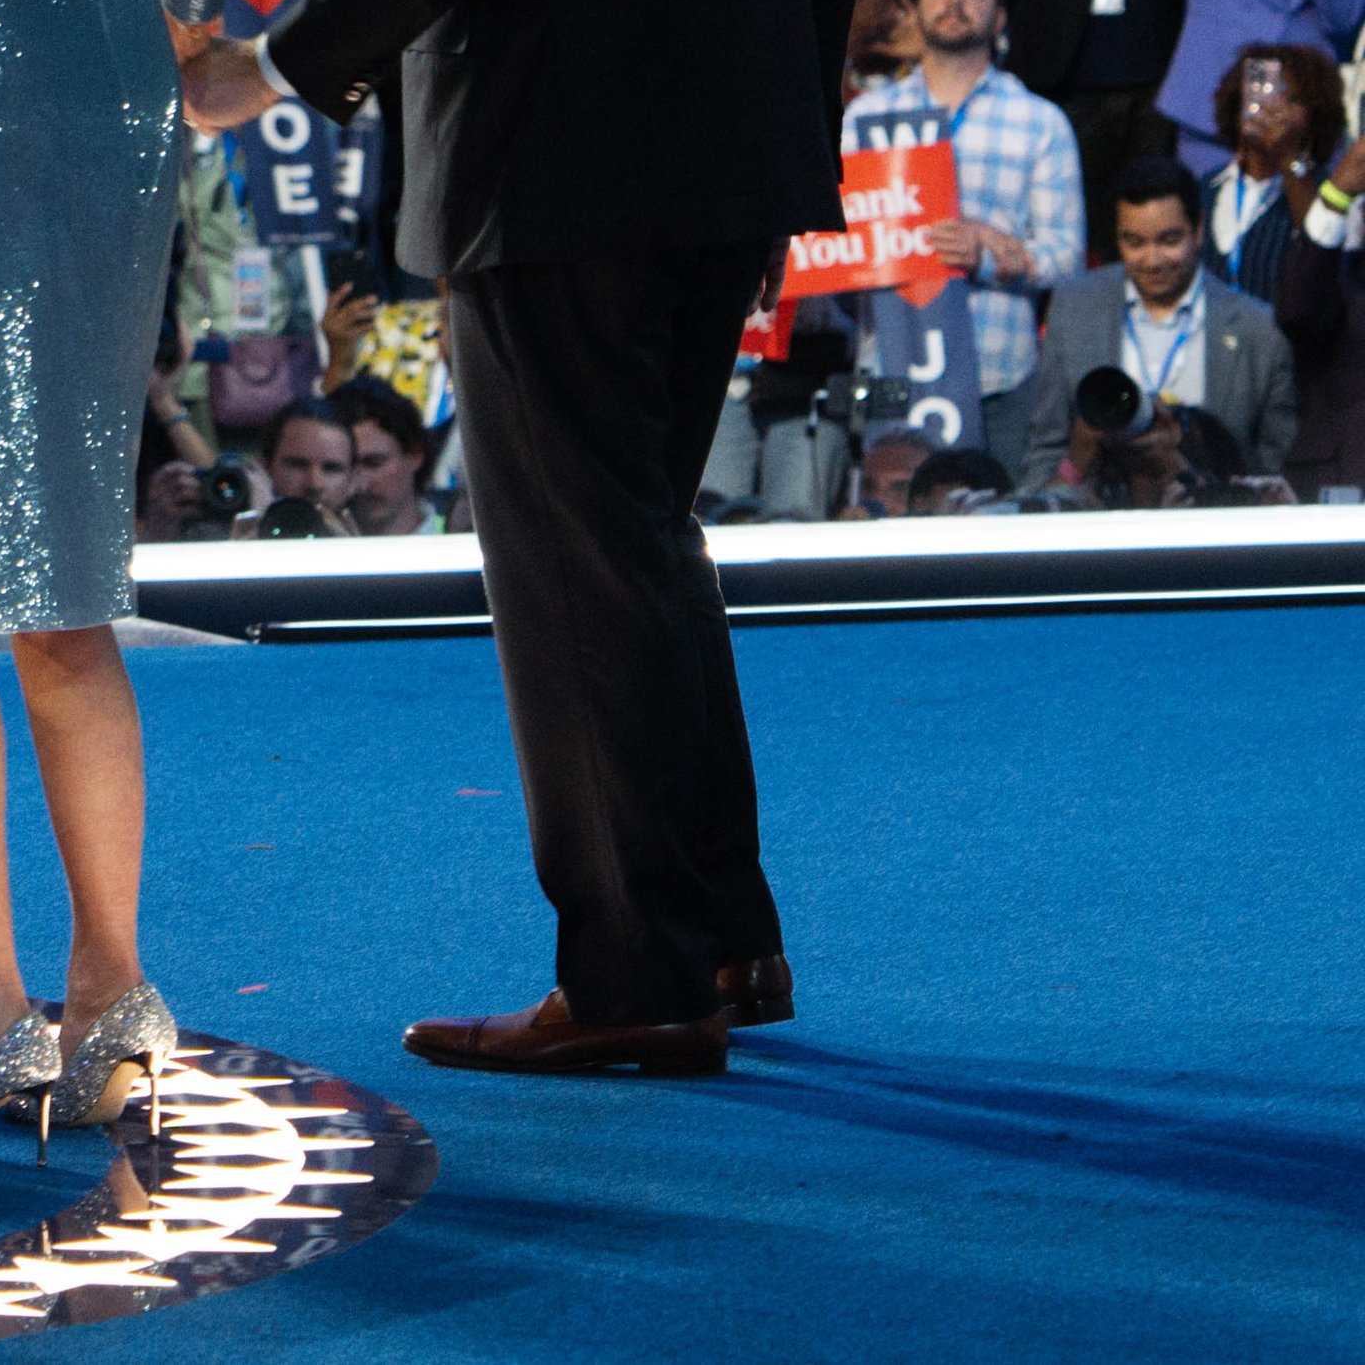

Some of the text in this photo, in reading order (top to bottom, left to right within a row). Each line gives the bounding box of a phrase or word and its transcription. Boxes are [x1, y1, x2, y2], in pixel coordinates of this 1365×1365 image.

[259, 102, 319, 215] OE
[844, 177, 924, 222] ank
[788, 232, 866, 273] You
[908, 329, 963, 446] JO
